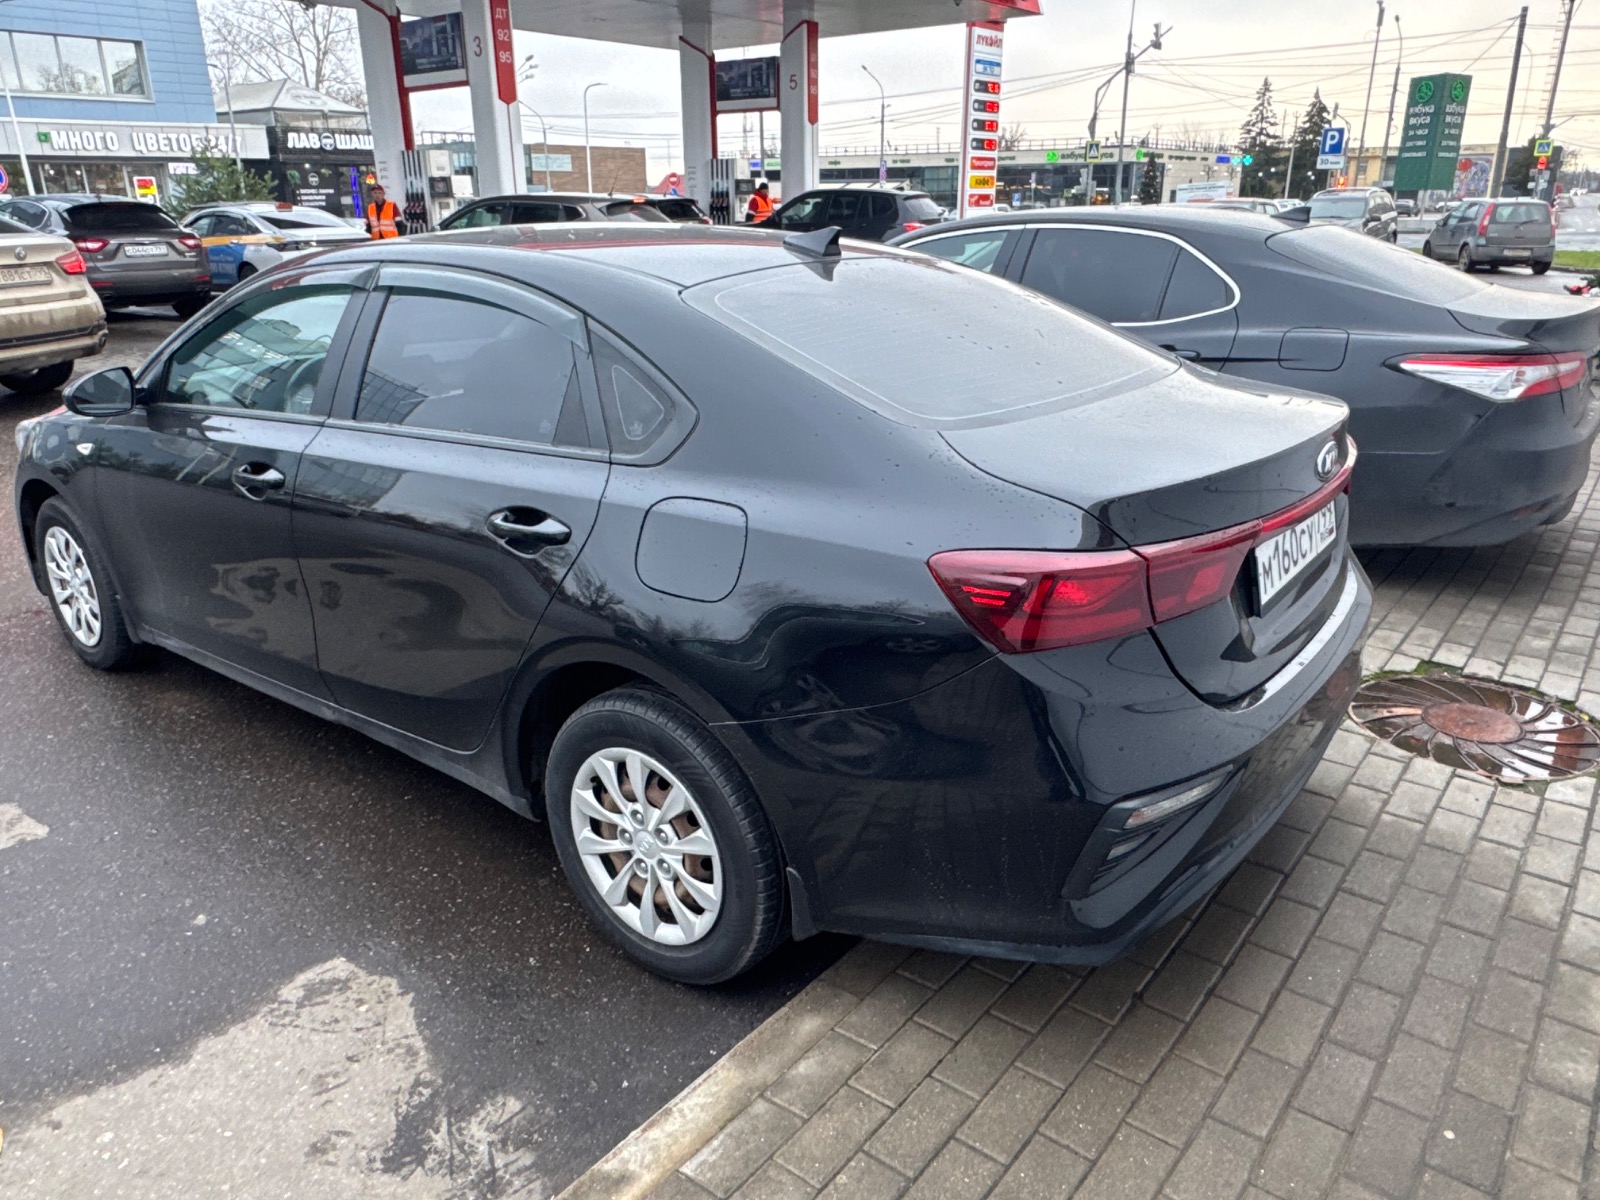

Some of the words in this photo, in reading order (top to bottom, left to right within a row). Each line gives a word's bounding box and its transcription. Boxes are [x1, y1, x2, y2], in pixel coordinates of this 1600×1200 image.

[496, 8, 508, 20] ДТ
[497, 29, 510, 42] 92
[473, 36, 483, 58] 3
[499, 51, 512, 64] 95
[789, 73, 798, 91] 5
[1409, 115, 1431, 127] вкуса
[50, 130, 120, 151] МНОГО
[132, 131, 202, 154] ЦВЕТОВ
[1325, 130, 1340, 152] P
[1319, 158, 1329, 166] 30
